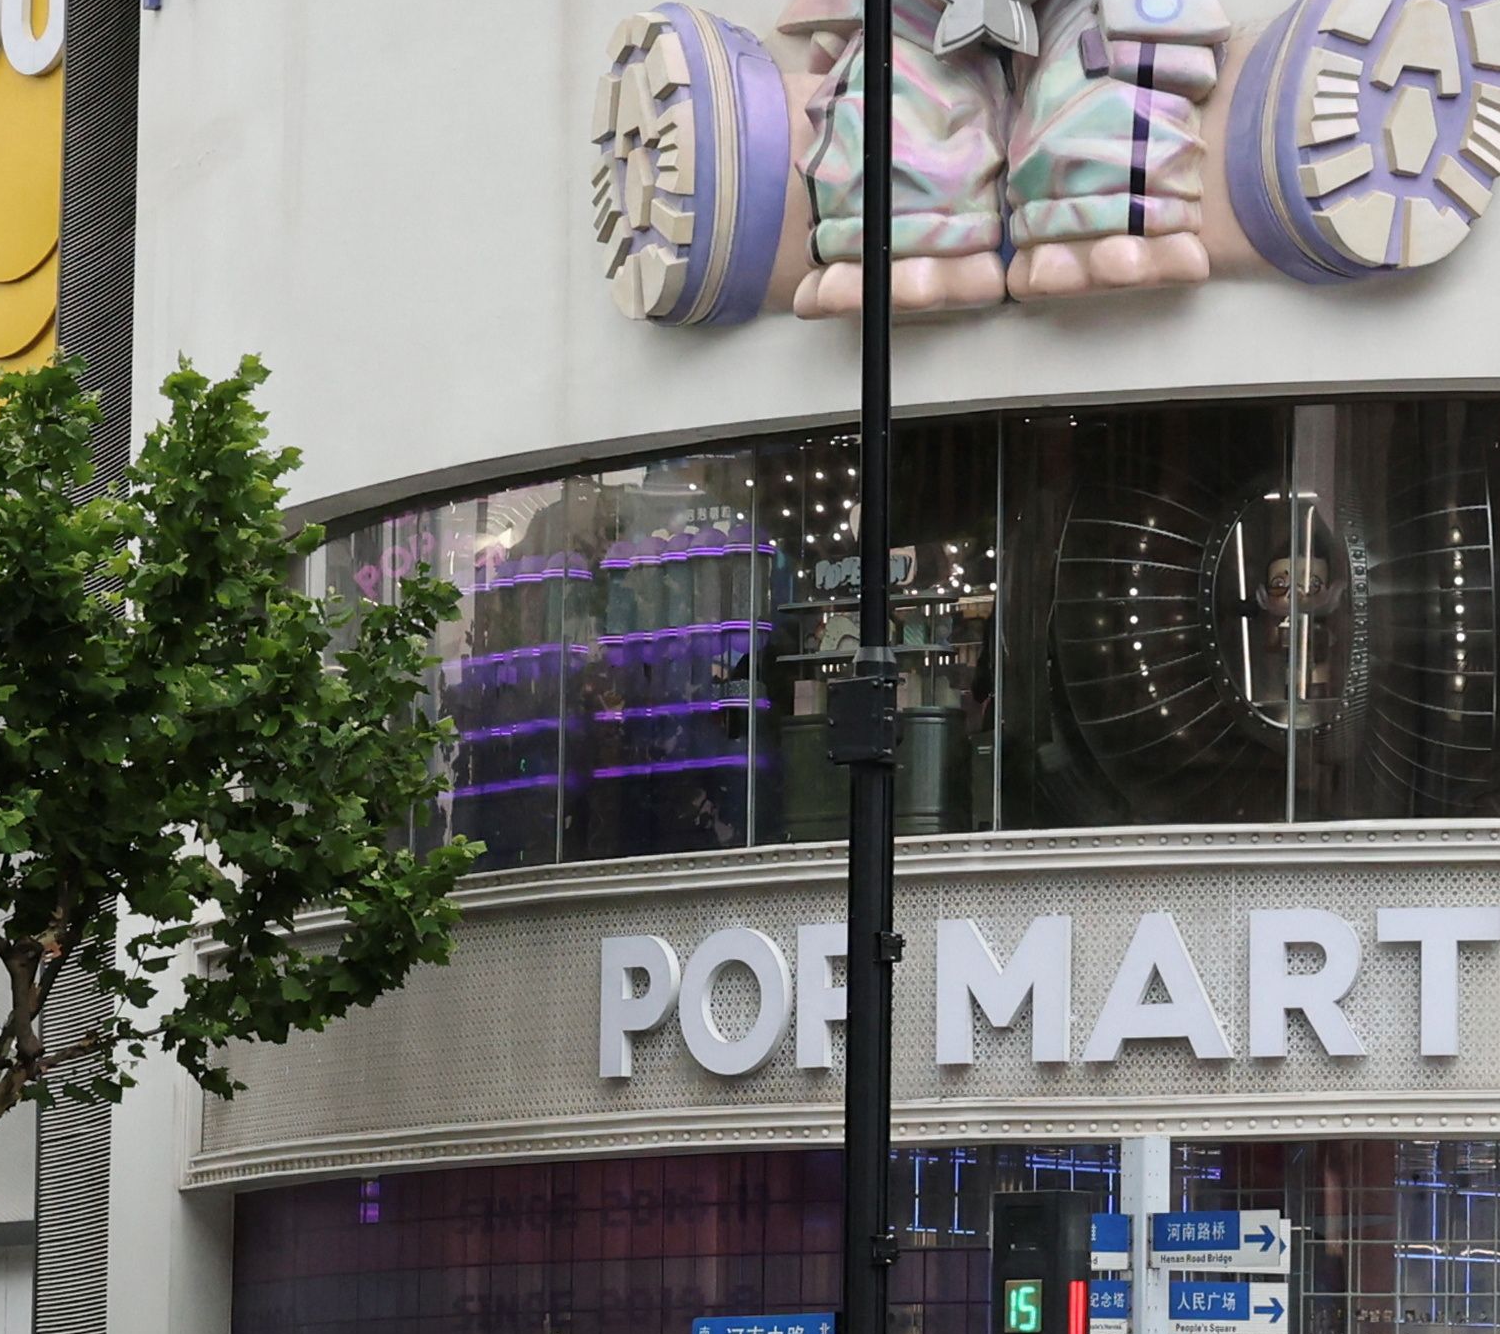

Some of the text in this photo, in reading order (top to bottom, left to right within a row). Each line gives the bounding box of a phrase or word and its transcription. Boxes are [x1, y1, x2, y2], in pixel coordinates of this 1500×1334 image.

[1167, 1221, 1226, 1242] 河南路桥
[1160, 1253, 1185, 1264] Henan
[1209, 1253, 1233, 1267] Bridge
[1009, 1285, 1037, 1332] 15
[1177, 1292, 1237, 1312] 人民广场
[1175, 1323, 1237, 1334] People's Square
